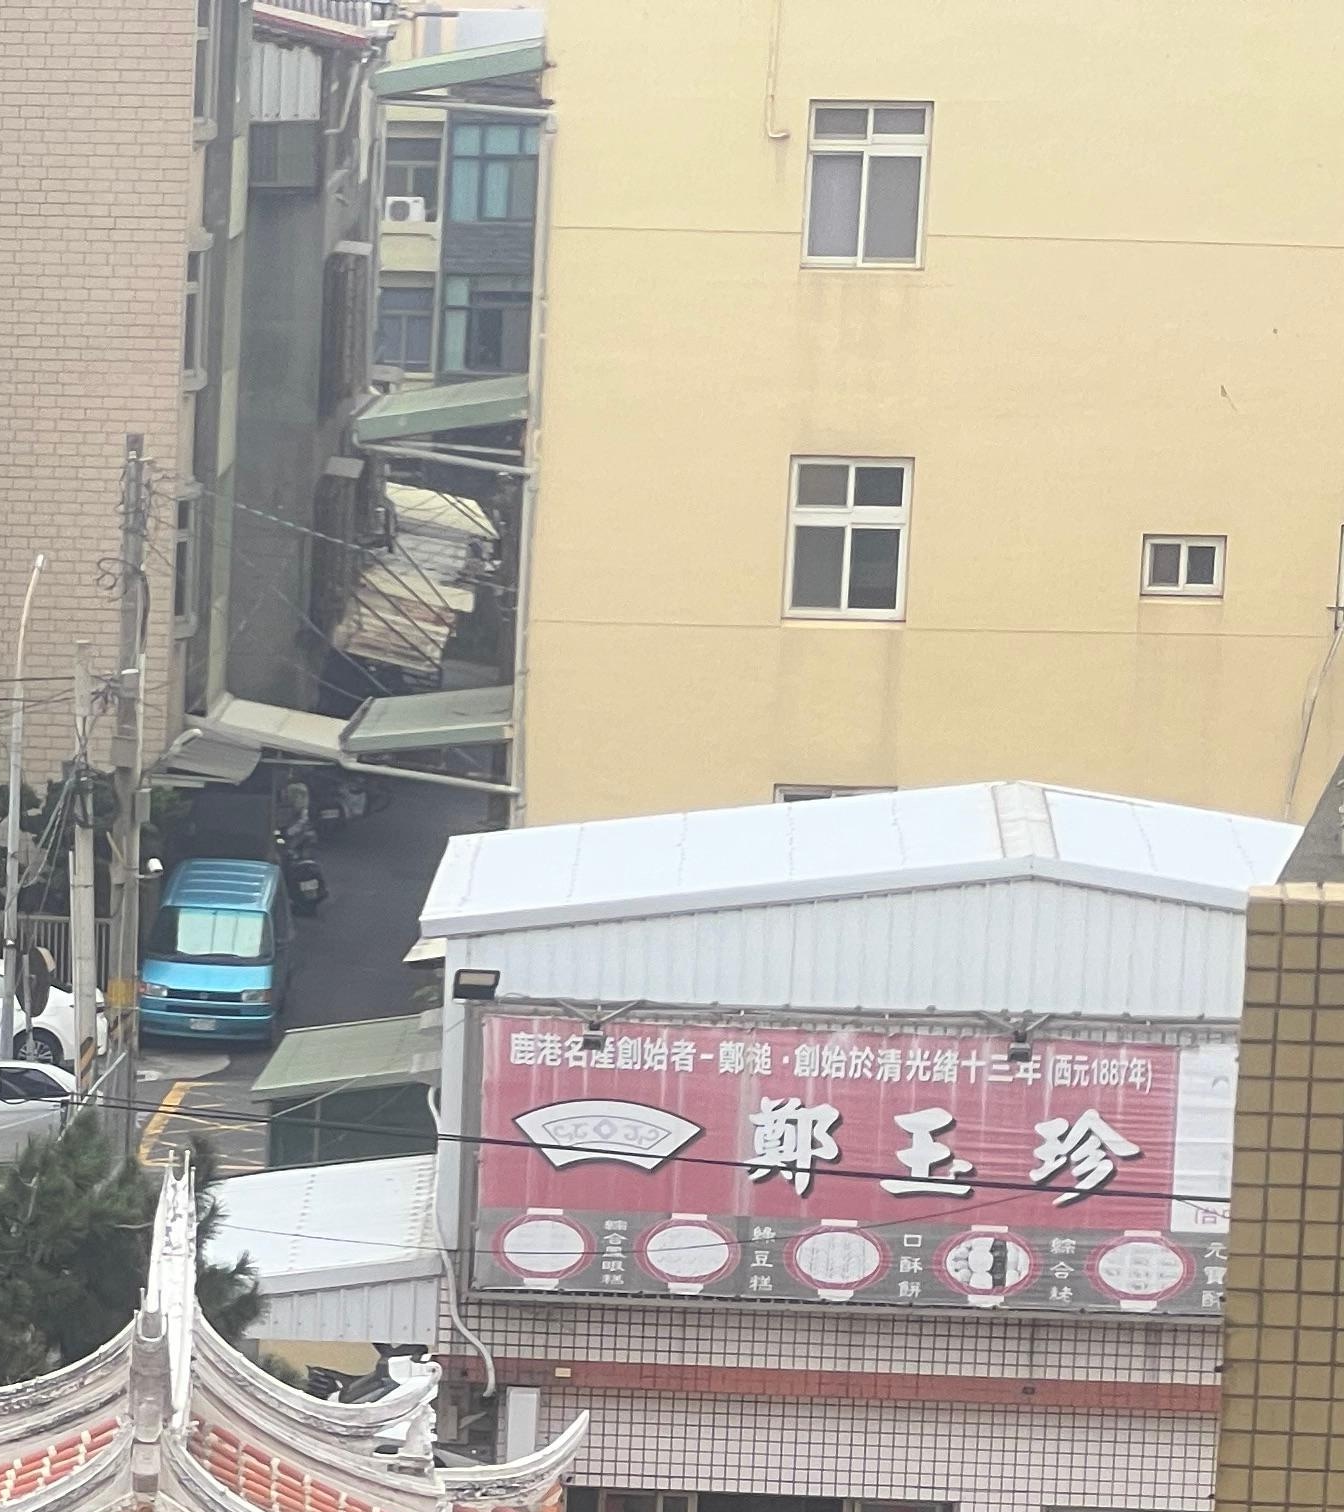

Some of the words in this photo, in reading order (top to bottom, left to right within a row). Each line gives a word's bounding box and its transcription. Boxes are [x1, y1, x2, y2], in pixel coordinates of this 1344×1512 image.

[748, 1096, 1142, 1207] 鄭玉珍
[898, 1233, 923, 1299] 口酥餅
